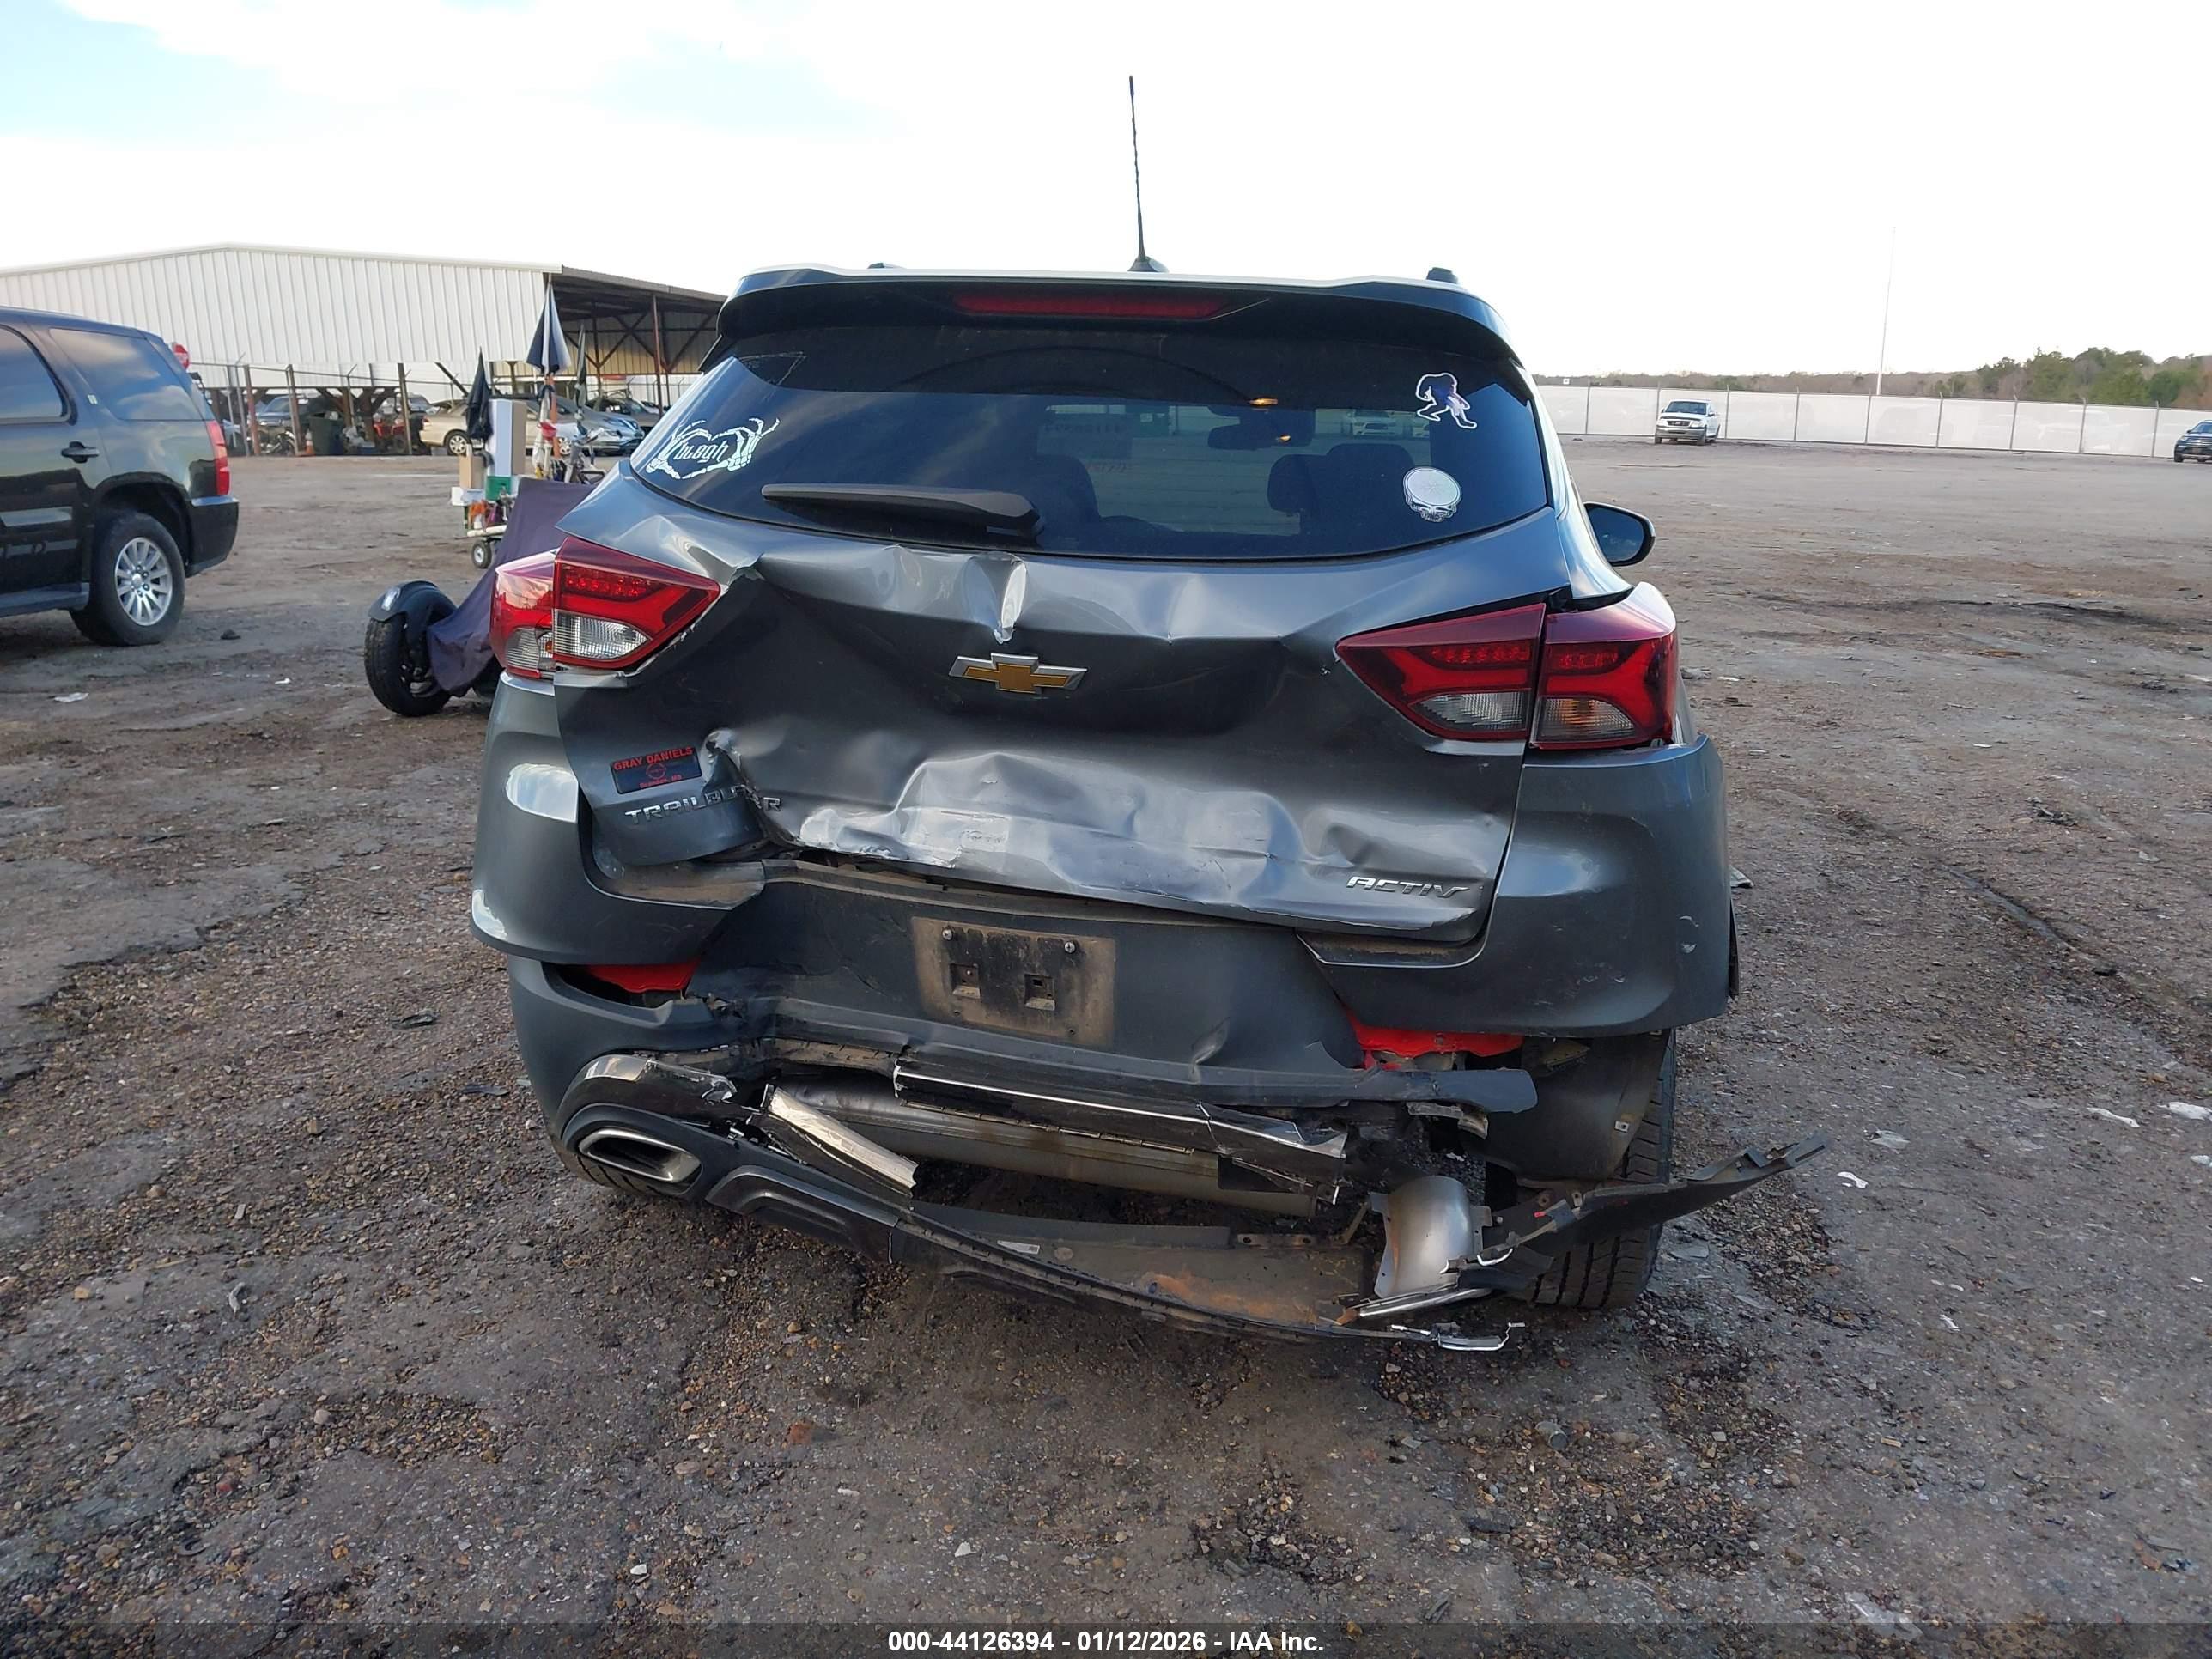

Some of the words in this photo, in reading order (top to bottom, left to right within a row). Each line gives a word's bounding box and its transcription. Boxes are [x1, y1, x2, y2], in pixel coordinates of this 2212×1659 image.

[613, 757, 642, 770] GRAY
[646, 746, 694, 763] DANIELS
[1346, 876, 1471, 898] ACTIV
